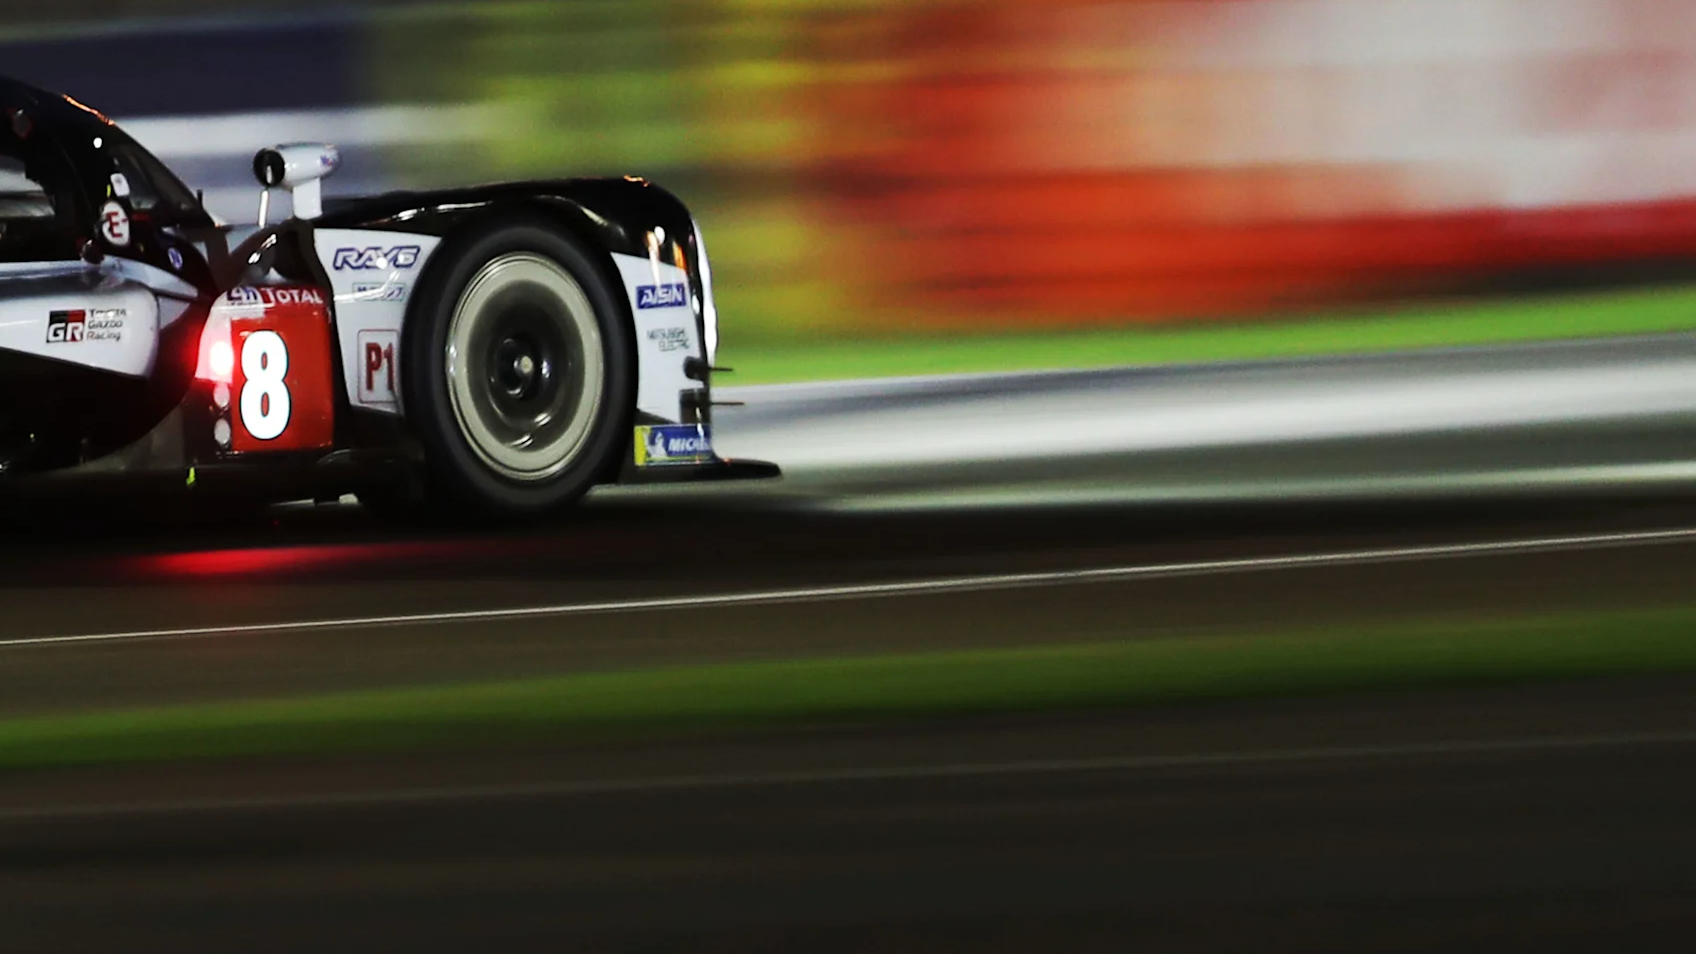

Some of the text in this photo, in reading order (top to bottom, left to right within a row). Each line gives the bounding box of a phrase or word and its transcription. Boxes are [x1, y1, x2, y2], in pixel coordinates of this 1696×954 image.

[333, 245, 421, 270] RAYS
[260, 287, 324, 305] TOTAL
[640, 287, 683, 306] AISIN
[47, 321, 84, 342] GR
[365, 342, 395, 391] P1
[239, 329, 292, 440] 8
